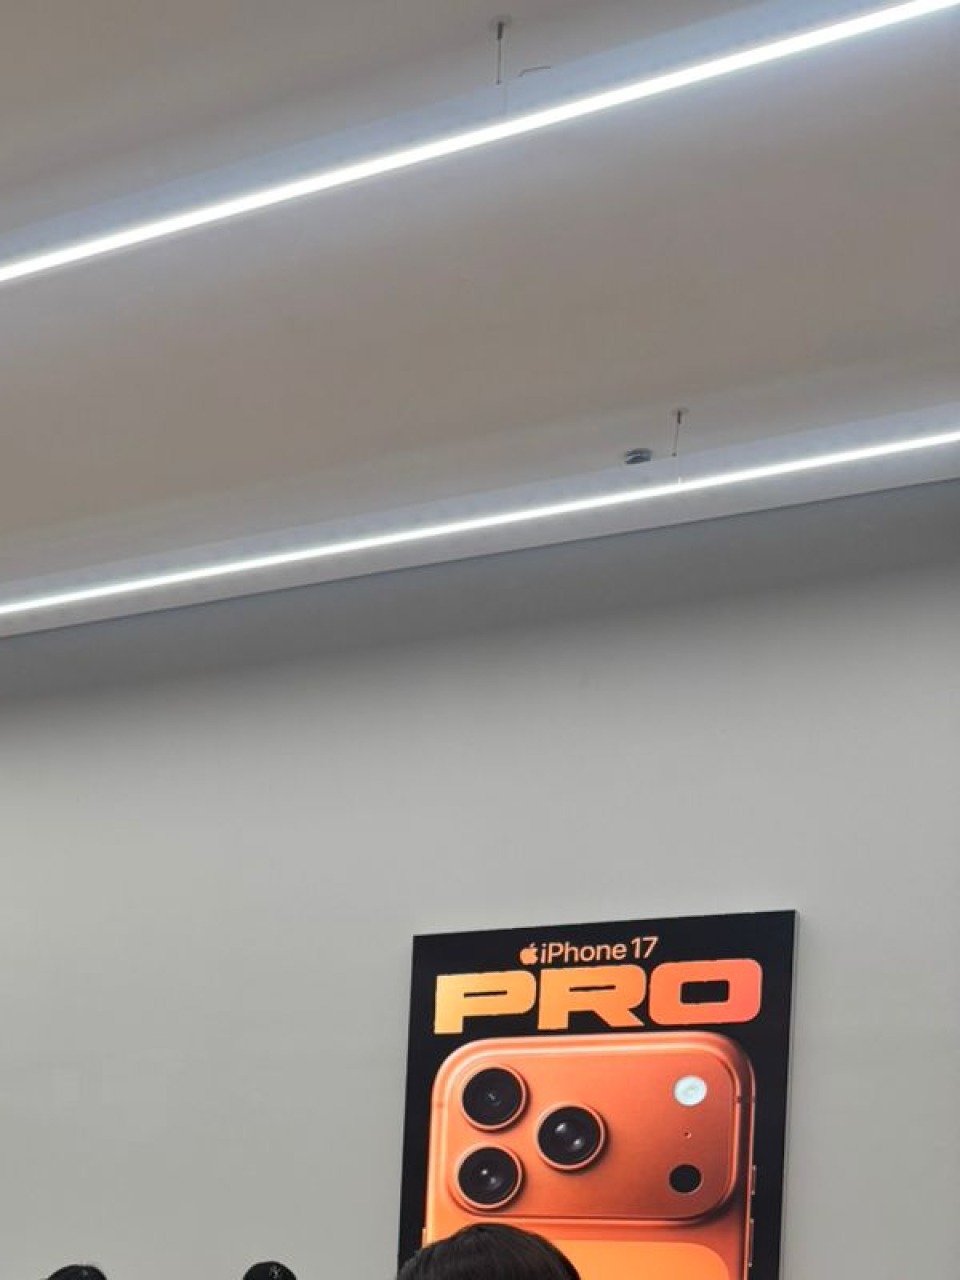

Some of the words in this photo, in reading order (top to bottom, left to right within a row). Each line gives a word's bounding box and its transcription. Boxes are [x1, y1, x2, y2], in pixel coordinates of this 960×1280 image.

[540, 941, 627, 963] iPhone
[631, 936, 659, 958] 17
[434, 958, 763, 1034] PRO
